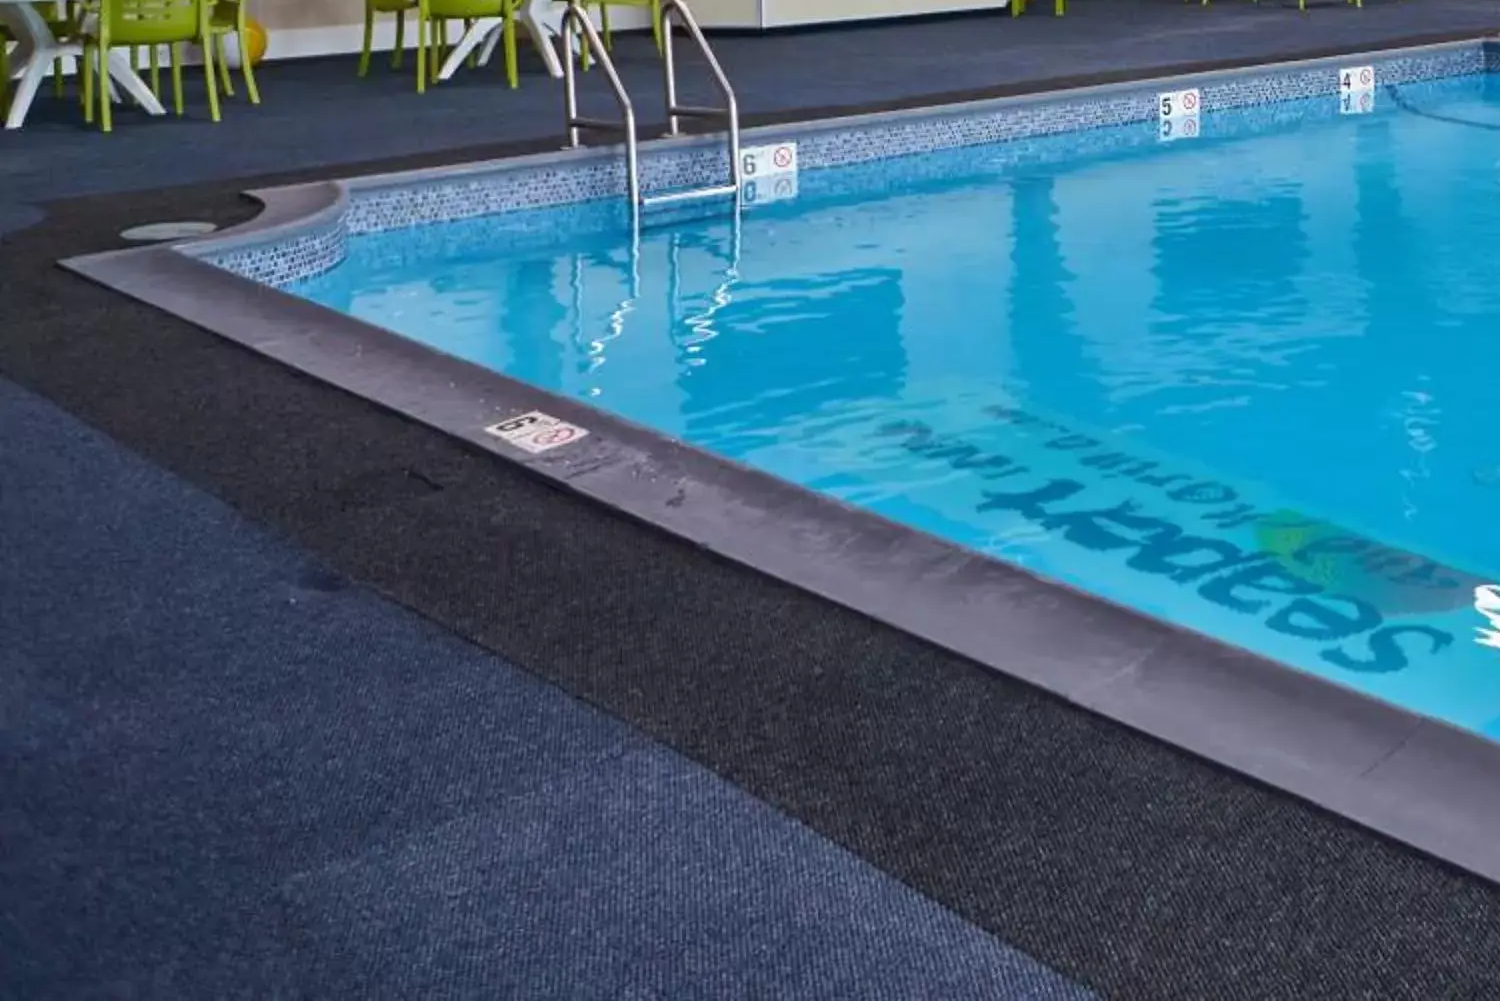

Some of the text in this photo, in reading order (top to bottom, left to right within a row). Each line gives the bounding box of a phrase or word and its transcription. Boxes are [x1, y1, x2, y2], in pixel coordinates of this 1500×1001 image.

[1343, 72, 1351, 90] 4
[1162, 97, 1172, 115] 5
[743, 154, 756, 175] 6
[976, 476, 1455, 675] Seaport
